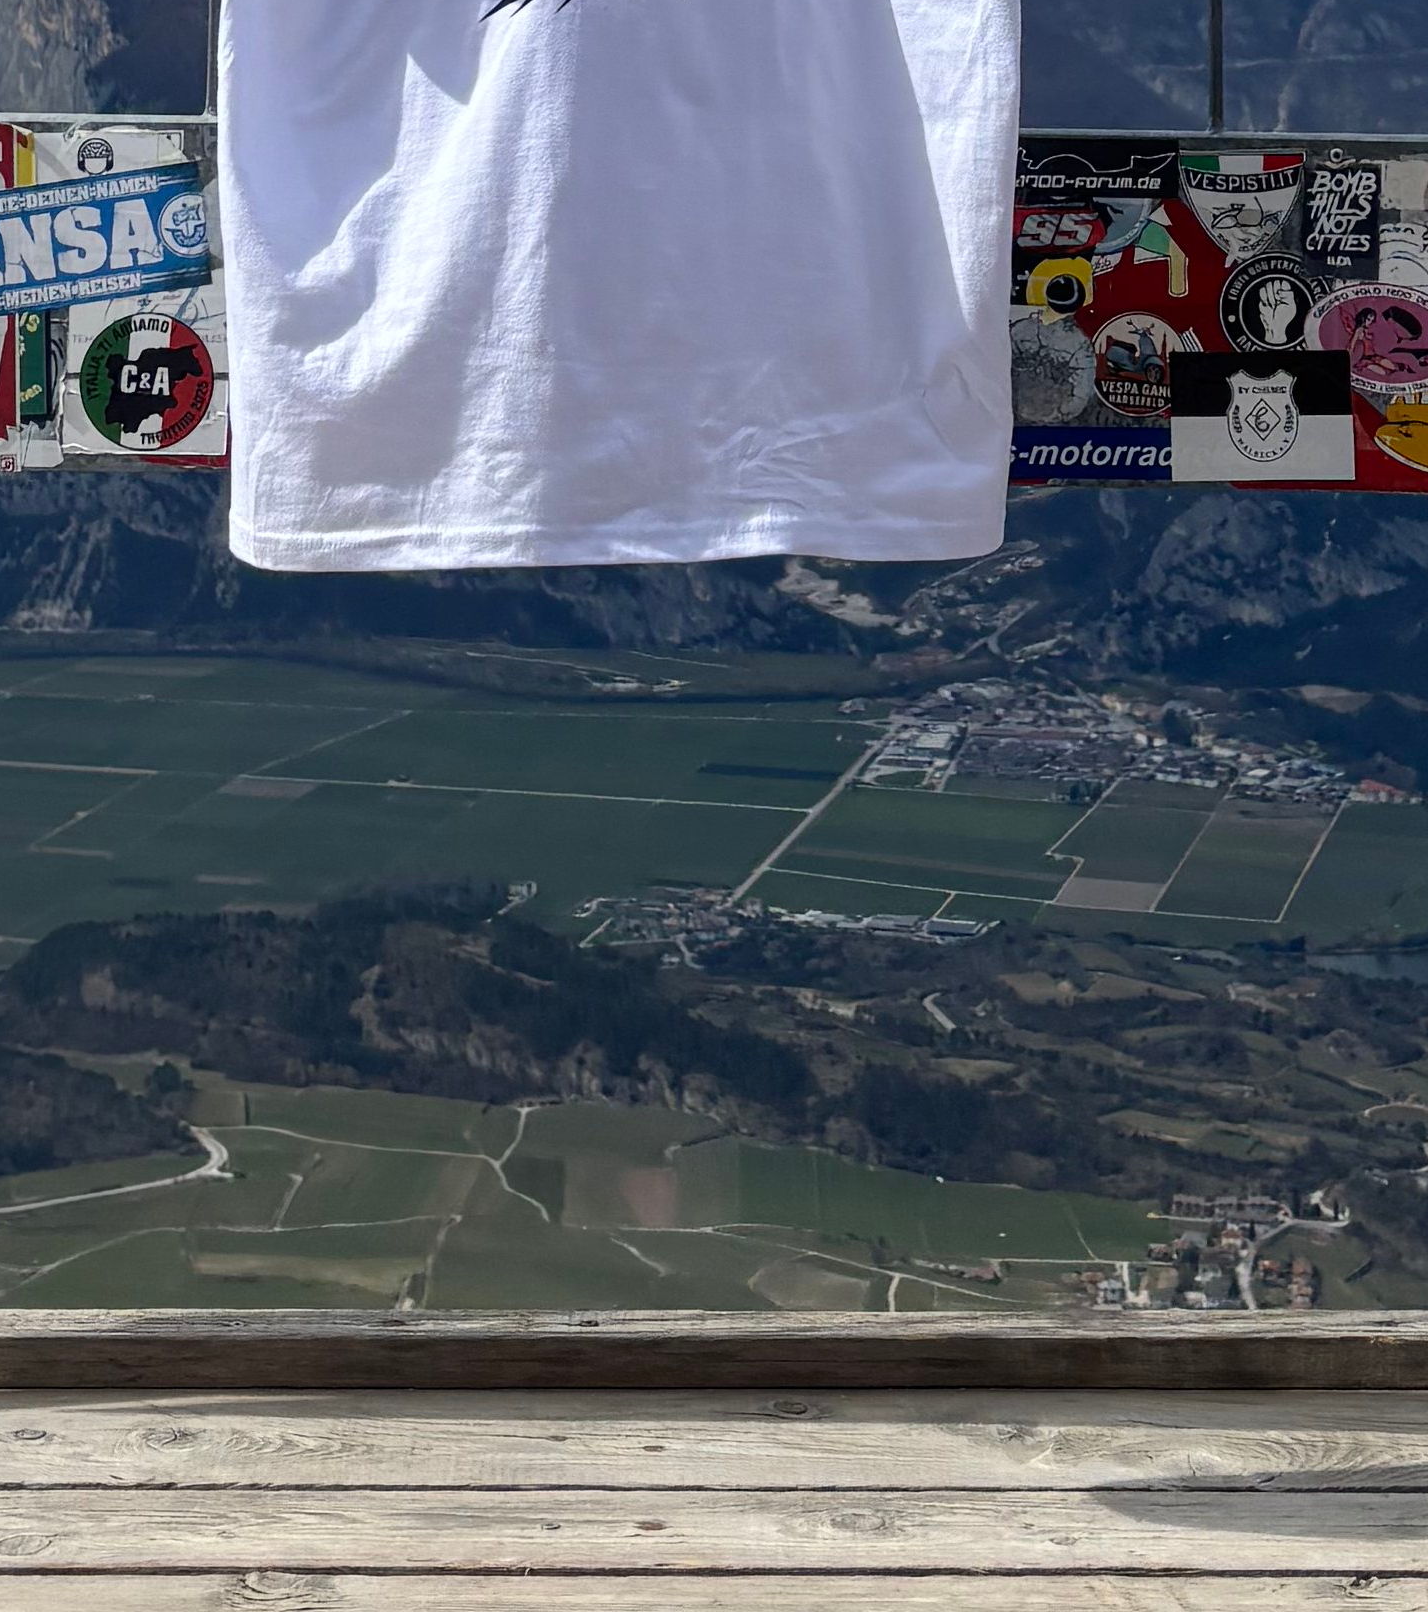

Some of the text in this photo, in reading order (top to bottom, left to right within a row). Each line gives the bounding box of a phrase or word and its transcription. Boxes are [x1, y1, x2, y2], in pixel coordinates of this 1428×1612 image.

[25, 185, 89, 209] DEINEN
[96, 175, 158, 199] NAMEN
[1189, 169, 1295, 192] VESPISTI.IT
[1308, 169, 1377, 195] BOMB
[1308, 193, 1372, 219] HILLS
[1315, 214, 1367, 234] NOT
[1306, 234, 1371, 252] CITIES
[4, 284, 70, 309] MEINEN
[77, 272, 141, 297] REISEN
[120, 365, 170, 396] C&A
[1101, 380, 1139, 395] VESPA
